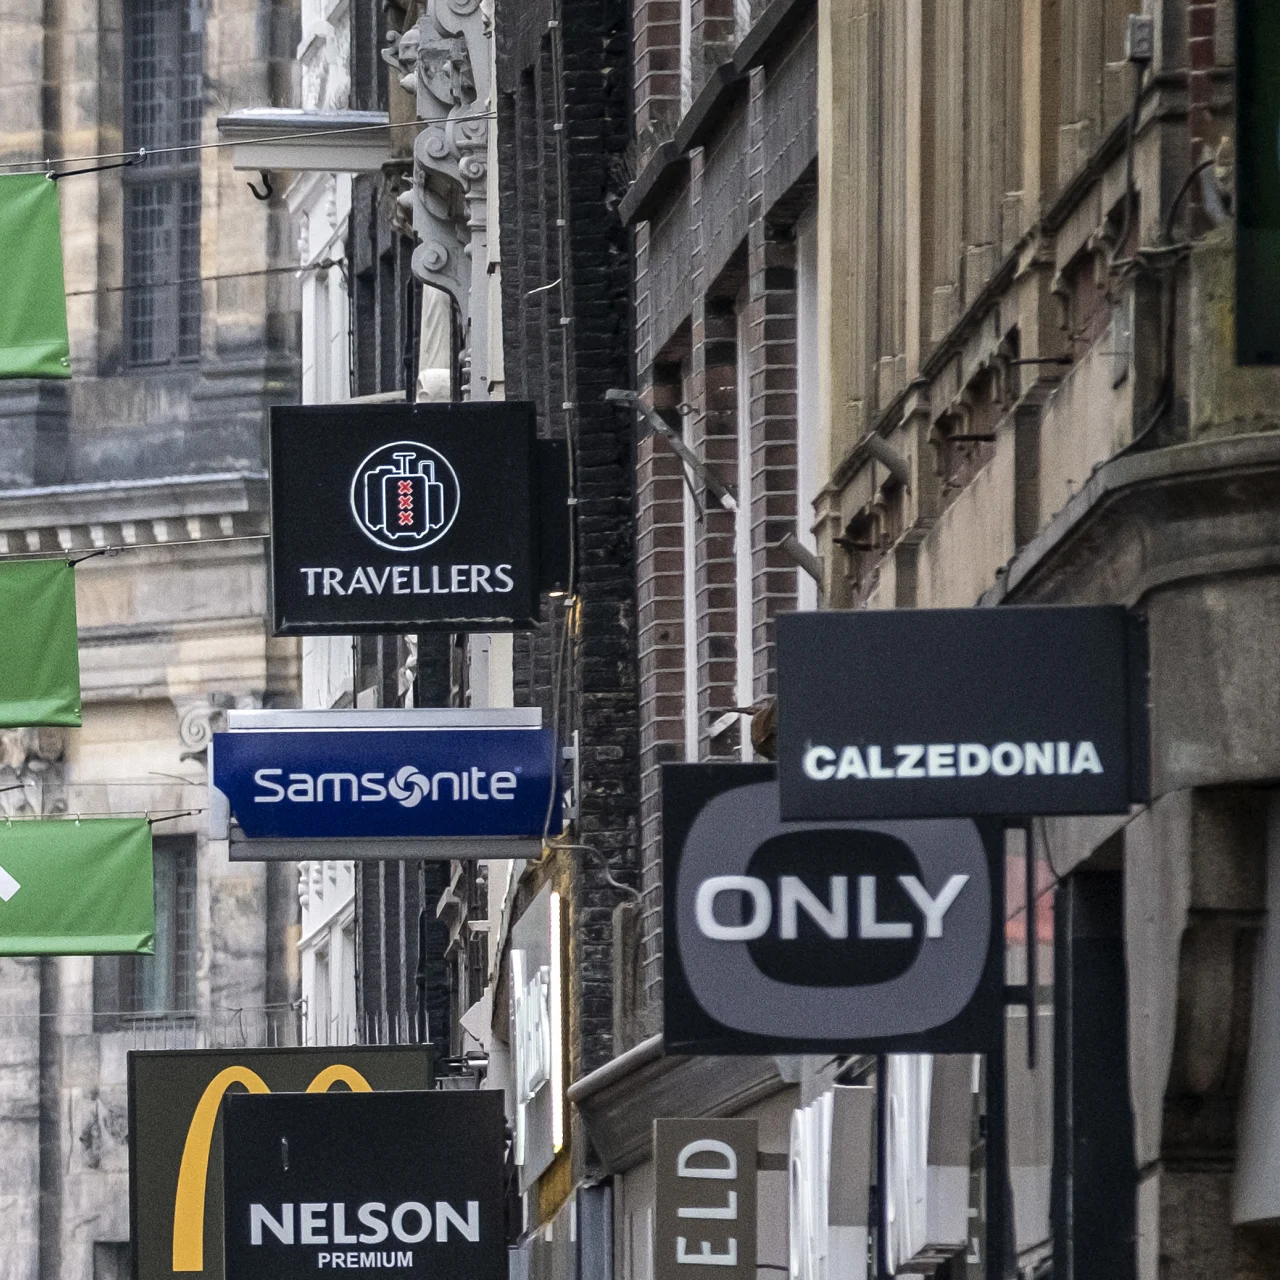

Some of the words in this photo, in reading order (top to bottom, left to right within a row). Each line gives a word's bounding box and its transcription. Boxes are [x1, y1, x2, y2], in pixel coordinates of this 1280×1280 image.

[300, 564, 515, 597] TRAVELLERS
[801, 740, 1104, 780] CALZEDONIA
[254, 765, 518, 808] Samsonite
[695, 874, 971, 942] ONLY
[249, 1201, 480, 1246] NELSON
[317, 1251, 414, 1269] PREMIUM
